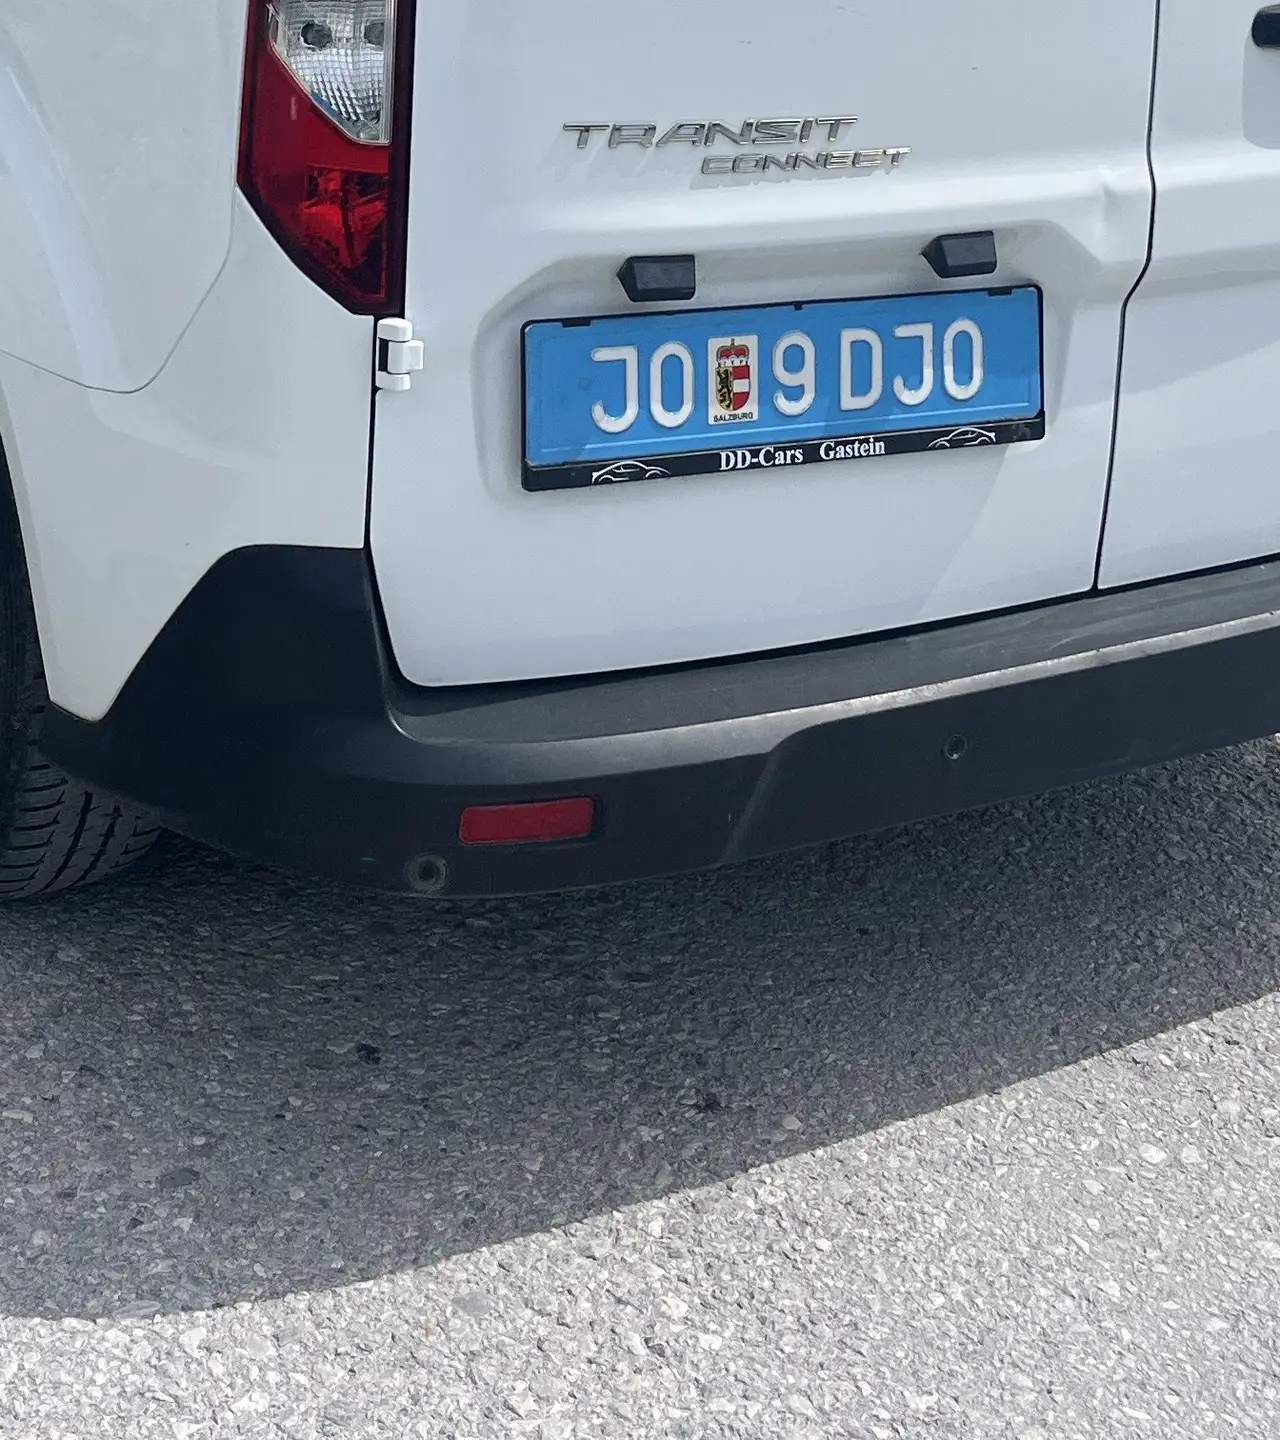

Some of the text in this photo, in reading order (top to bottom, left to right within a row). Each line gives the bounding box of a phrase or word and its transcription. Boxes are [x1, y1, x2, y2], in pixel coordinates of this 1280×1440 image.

[563, 115, 858, 148] TRANSIT
[701, 146, 912, 175] CONNECT
[590, 341, 696, 434] JO
[713, 411, 754, 422] SALZBURG
[720, 437, 886, 470] DD-Cars Gastein
